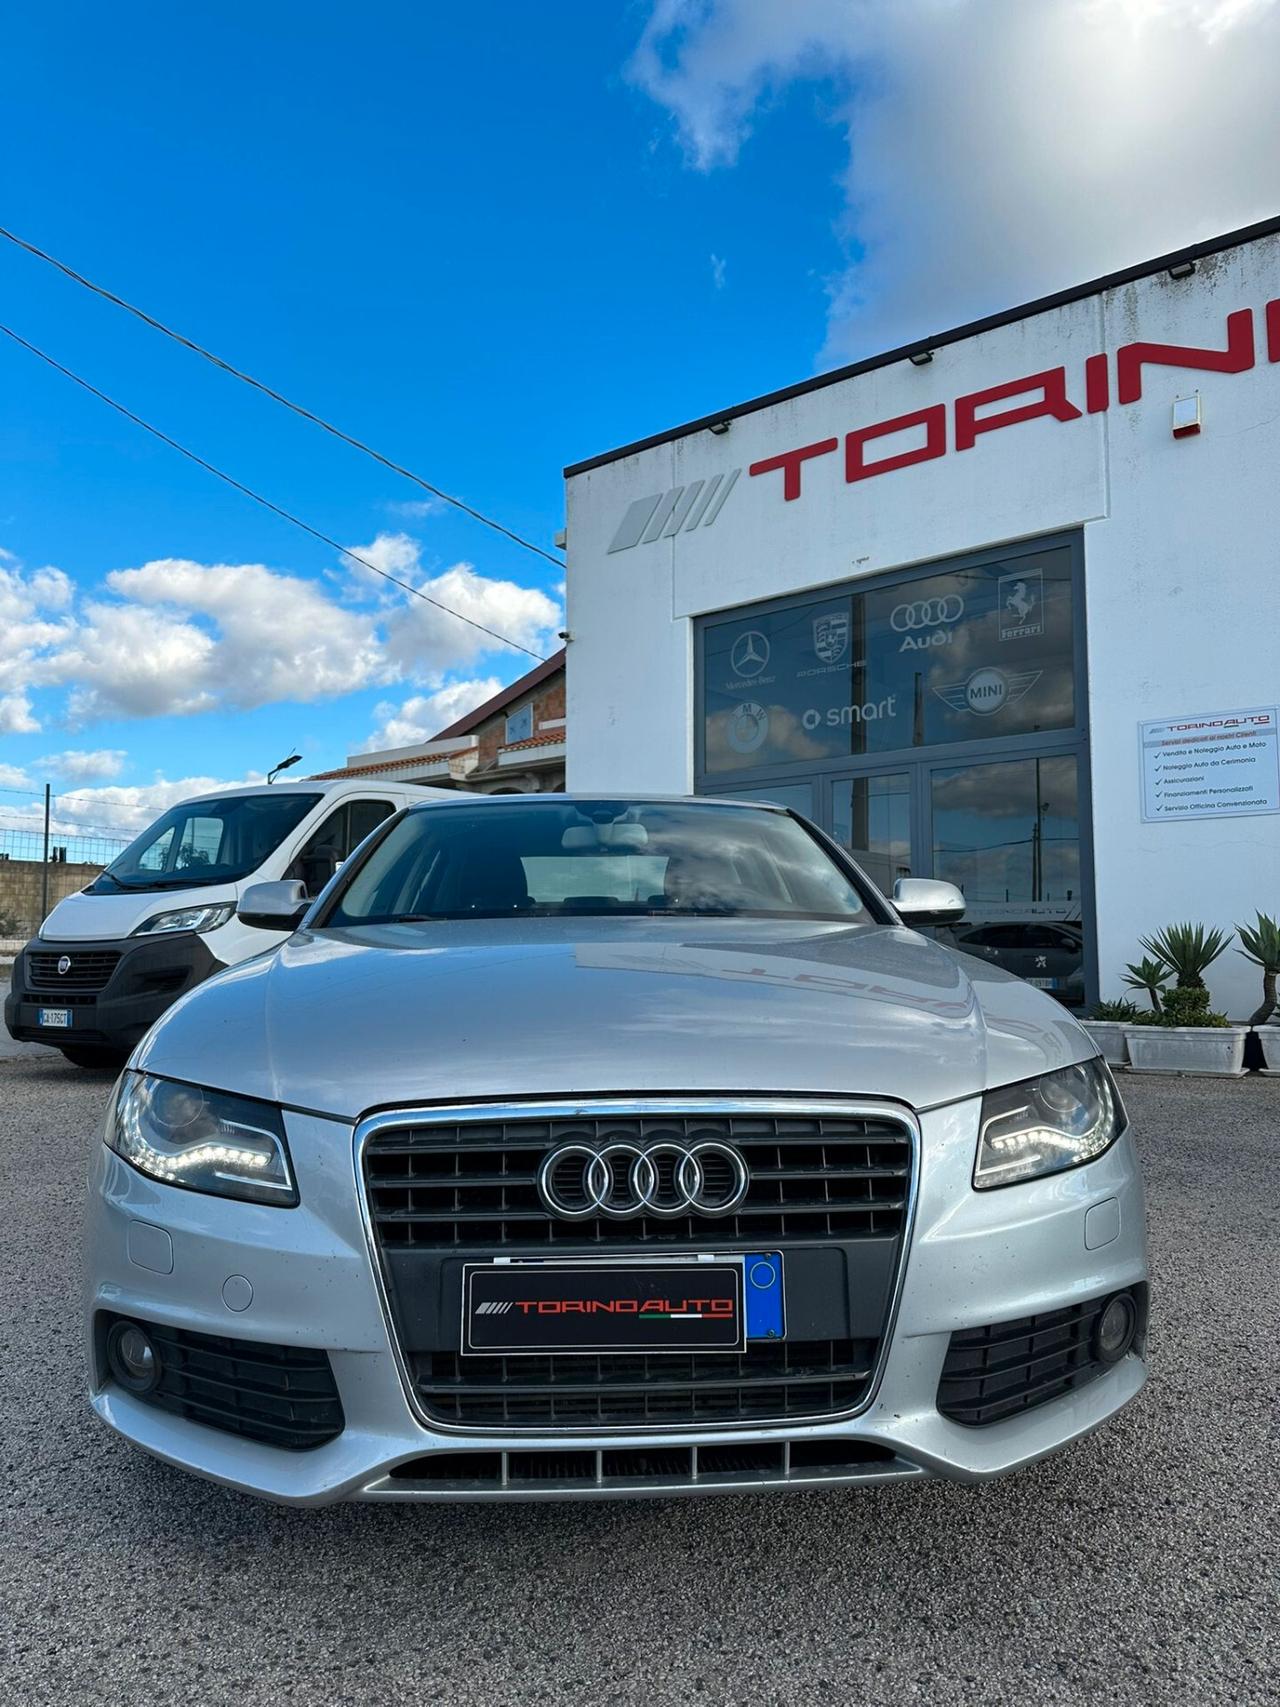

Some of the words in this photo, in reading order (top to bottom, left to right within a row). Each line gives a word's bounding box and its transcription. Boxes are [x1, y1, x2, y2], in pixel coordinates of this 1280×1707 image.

[749, 299, 1280, 502] TORIN
[1001, 625, 1042, 639] Ferrari
[899, 630, 953, 653] Audi
[796, 660, 867, 677] PORSCHE
[970, 684, 1003, 699] MINI
[826, 694, 897, 726] smart
[1167, 715, 1270, 731] TORINOAUTO
[1163, 749, 1186, 757] Vendita
[1194, 746, 1224, 754] Noleggio
[1221, 757, 1256, 765] Cerimonia
[1164, 776, 1204, 784] Assicurazioni
[1164, 789, 1208, 798] Finanziamenti
[1209, 786, 1253, 794] Personalizzati
[1190, 801, 1215, 809] Officina
[515, 1299, 733, 1314] TORINOAUTO
